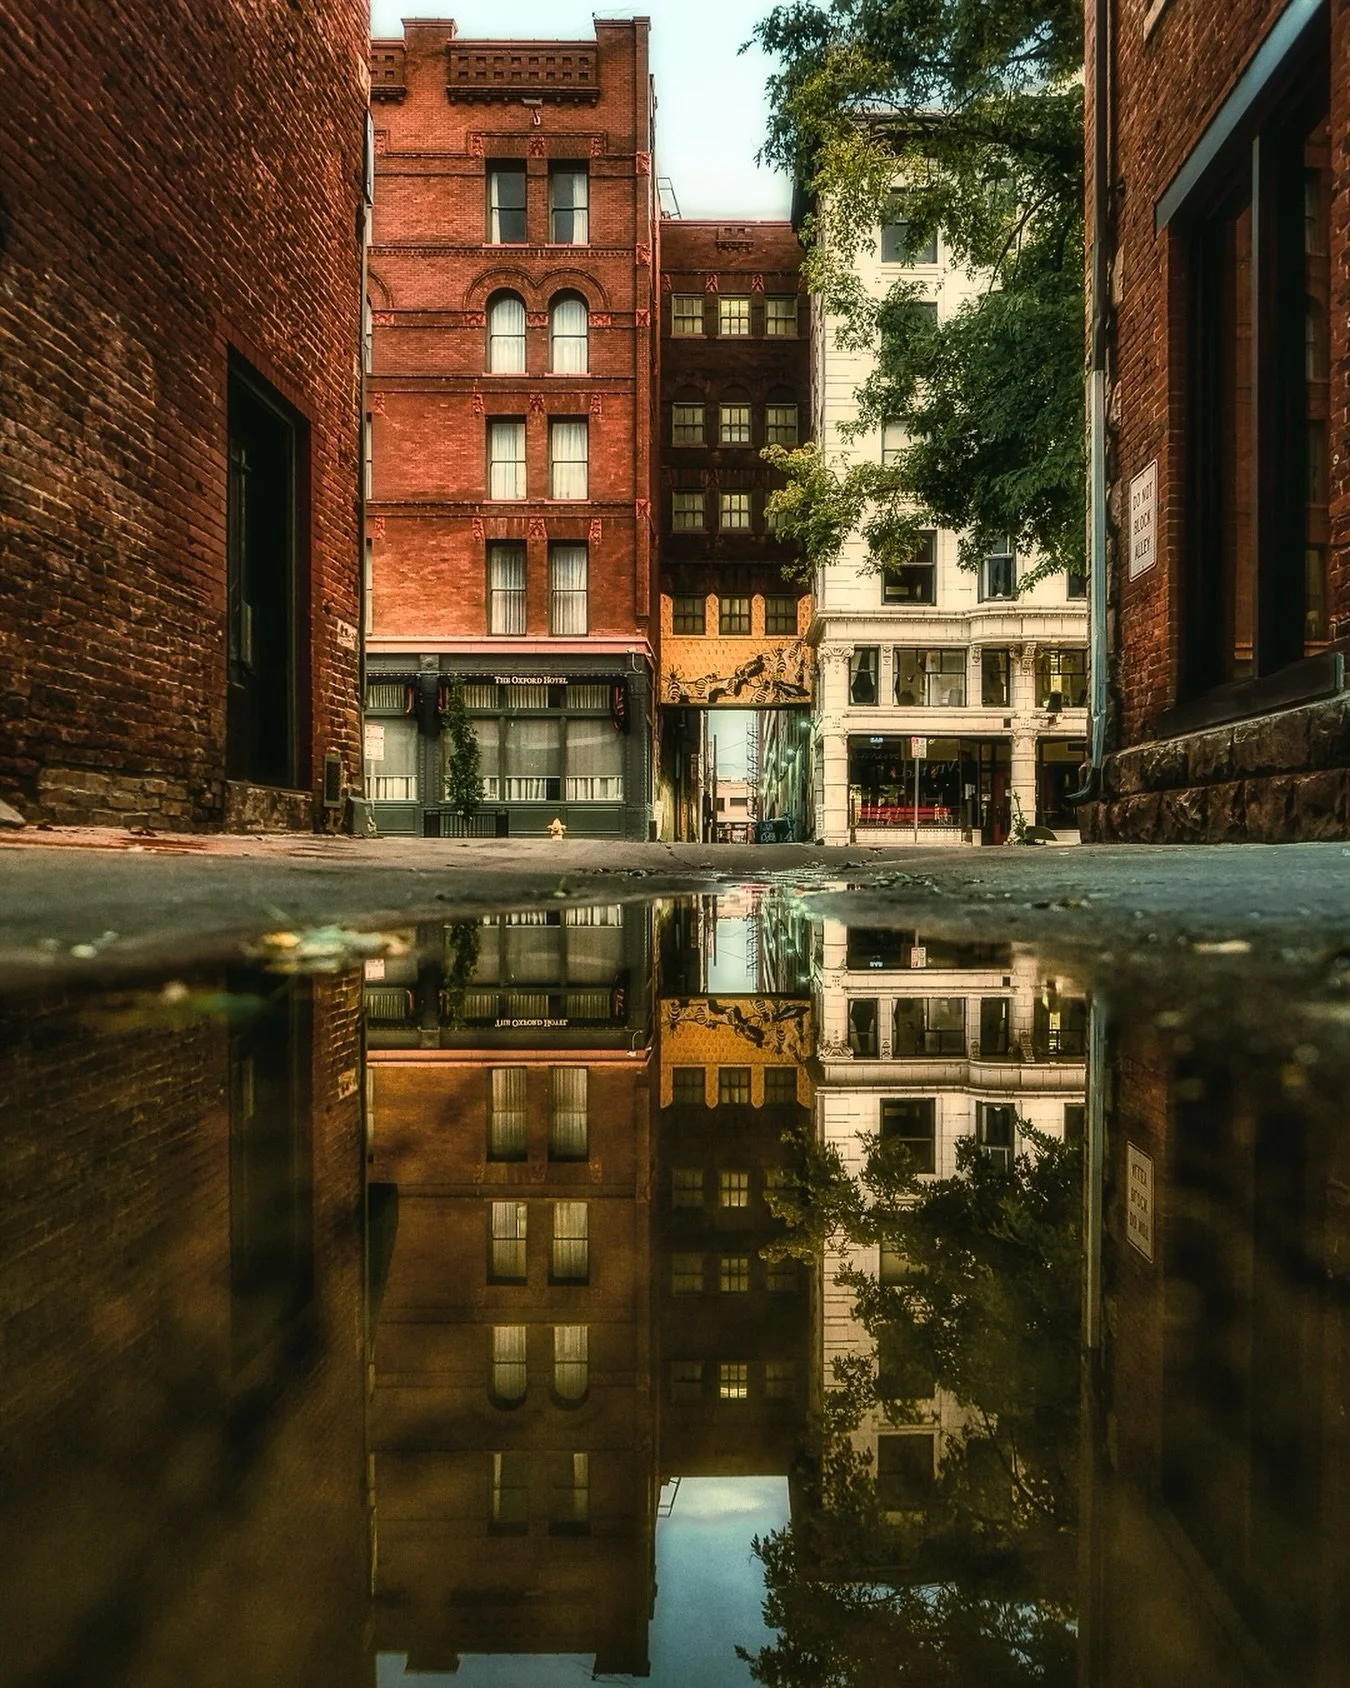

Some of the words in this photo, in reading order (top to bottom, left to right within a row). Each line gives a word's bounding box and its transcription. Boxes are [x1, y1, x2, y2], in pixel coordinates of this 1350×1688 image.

[1133, 492, 1141, 511] DO
[1141, 481, 1153, 504] NOT
[1134, 509, 1151, 535] BLOCK
[1134, 536, 1151, 560] ALLEY
[494, 676, 511, 684] THE
[511, 676, 543, 684] OXFORD
[543, 676, 568, 684] HOTEL
